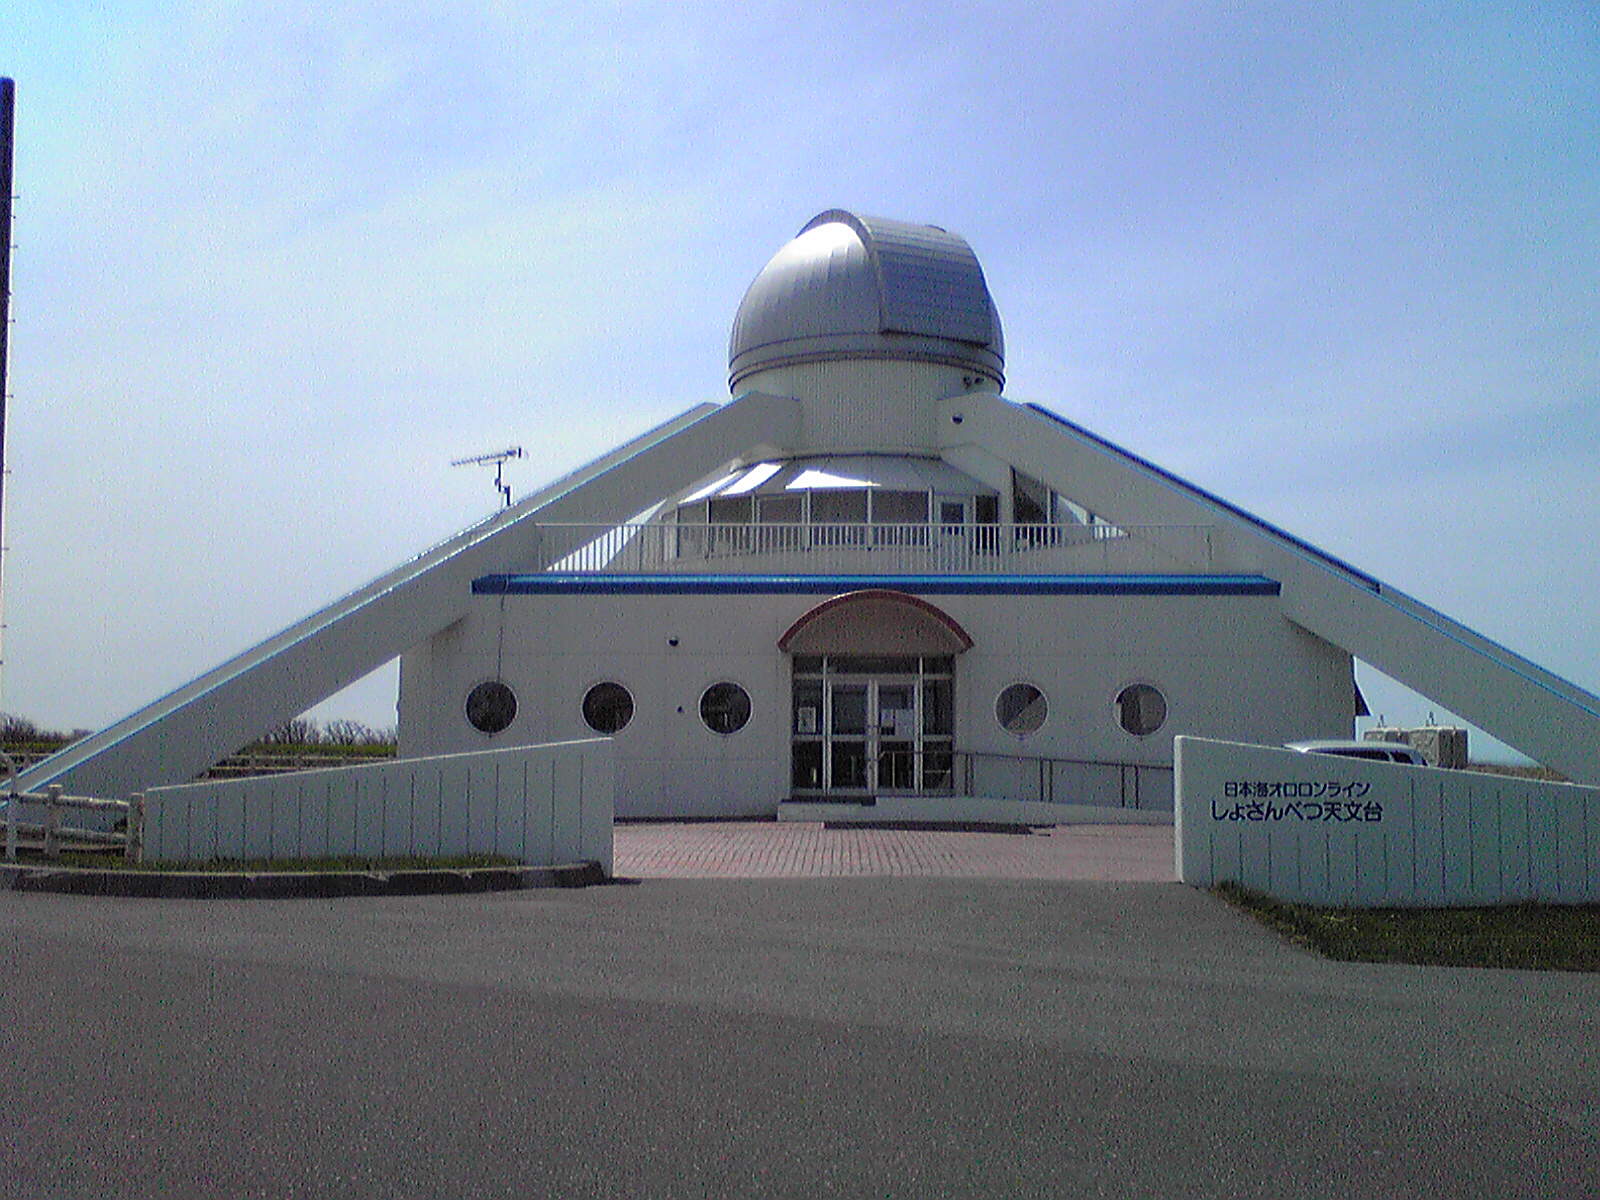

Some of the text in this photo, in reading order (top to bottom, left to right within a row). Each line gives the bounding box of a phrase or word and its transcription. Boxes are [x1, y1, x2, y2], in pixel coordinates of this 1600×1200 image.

[1224, 781, 1371, 798] 日本海オロロンライン
[1211, 800, 1383, 822] しょさんべつ天文台
